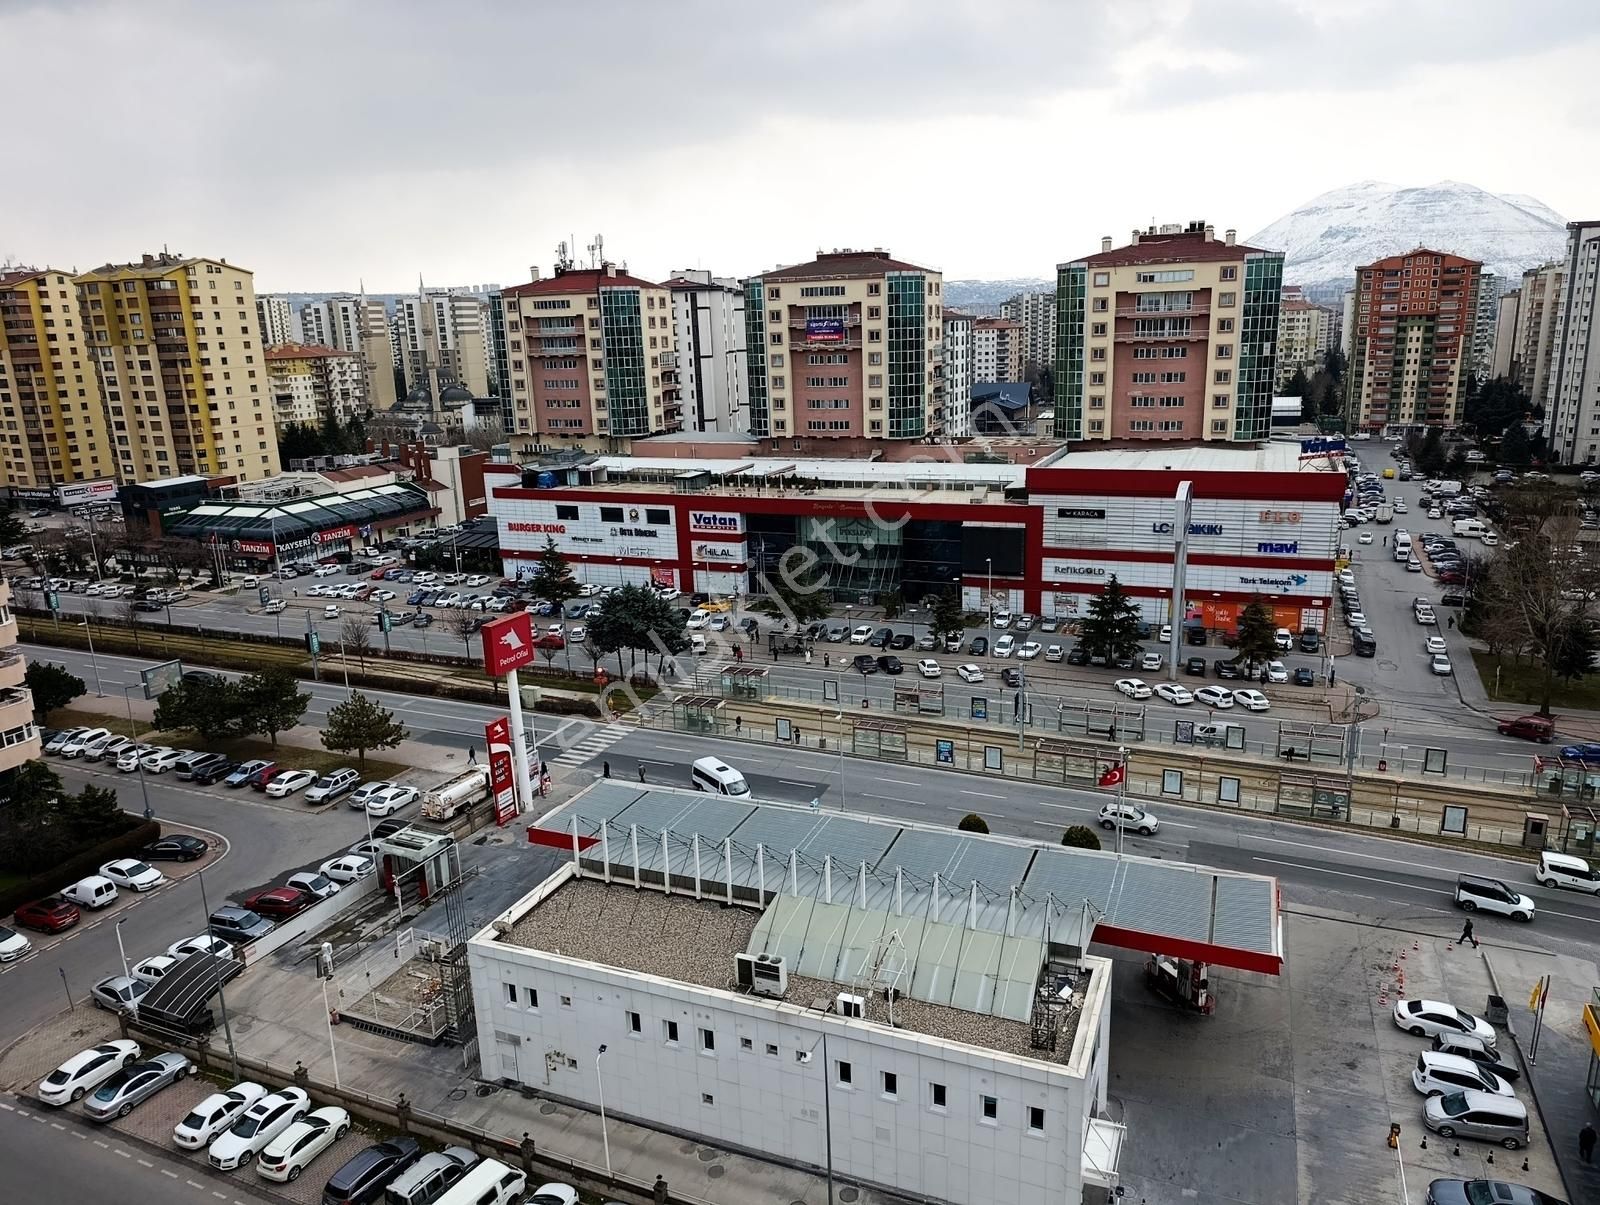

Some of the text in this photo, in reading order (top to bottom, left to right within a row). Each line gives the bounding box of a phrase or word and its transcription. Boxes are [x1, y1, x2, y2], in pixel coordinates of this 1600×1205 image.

[692, 513, 737, 526] Vatan
[508, 522, 566, 534] BURGER KING
[1152, 522, 1170, 533] LC
[322, 527, 351, 542] TANZİM
[241, 544, 270, 554] TANZİM
[279, 537, 311, 552] KAYSERİ
[1257, 541, 1298, 554] mavi
[1239, 576, 1292, 587] Türk Telekom
[499, 654, 516, 667] Petrol
